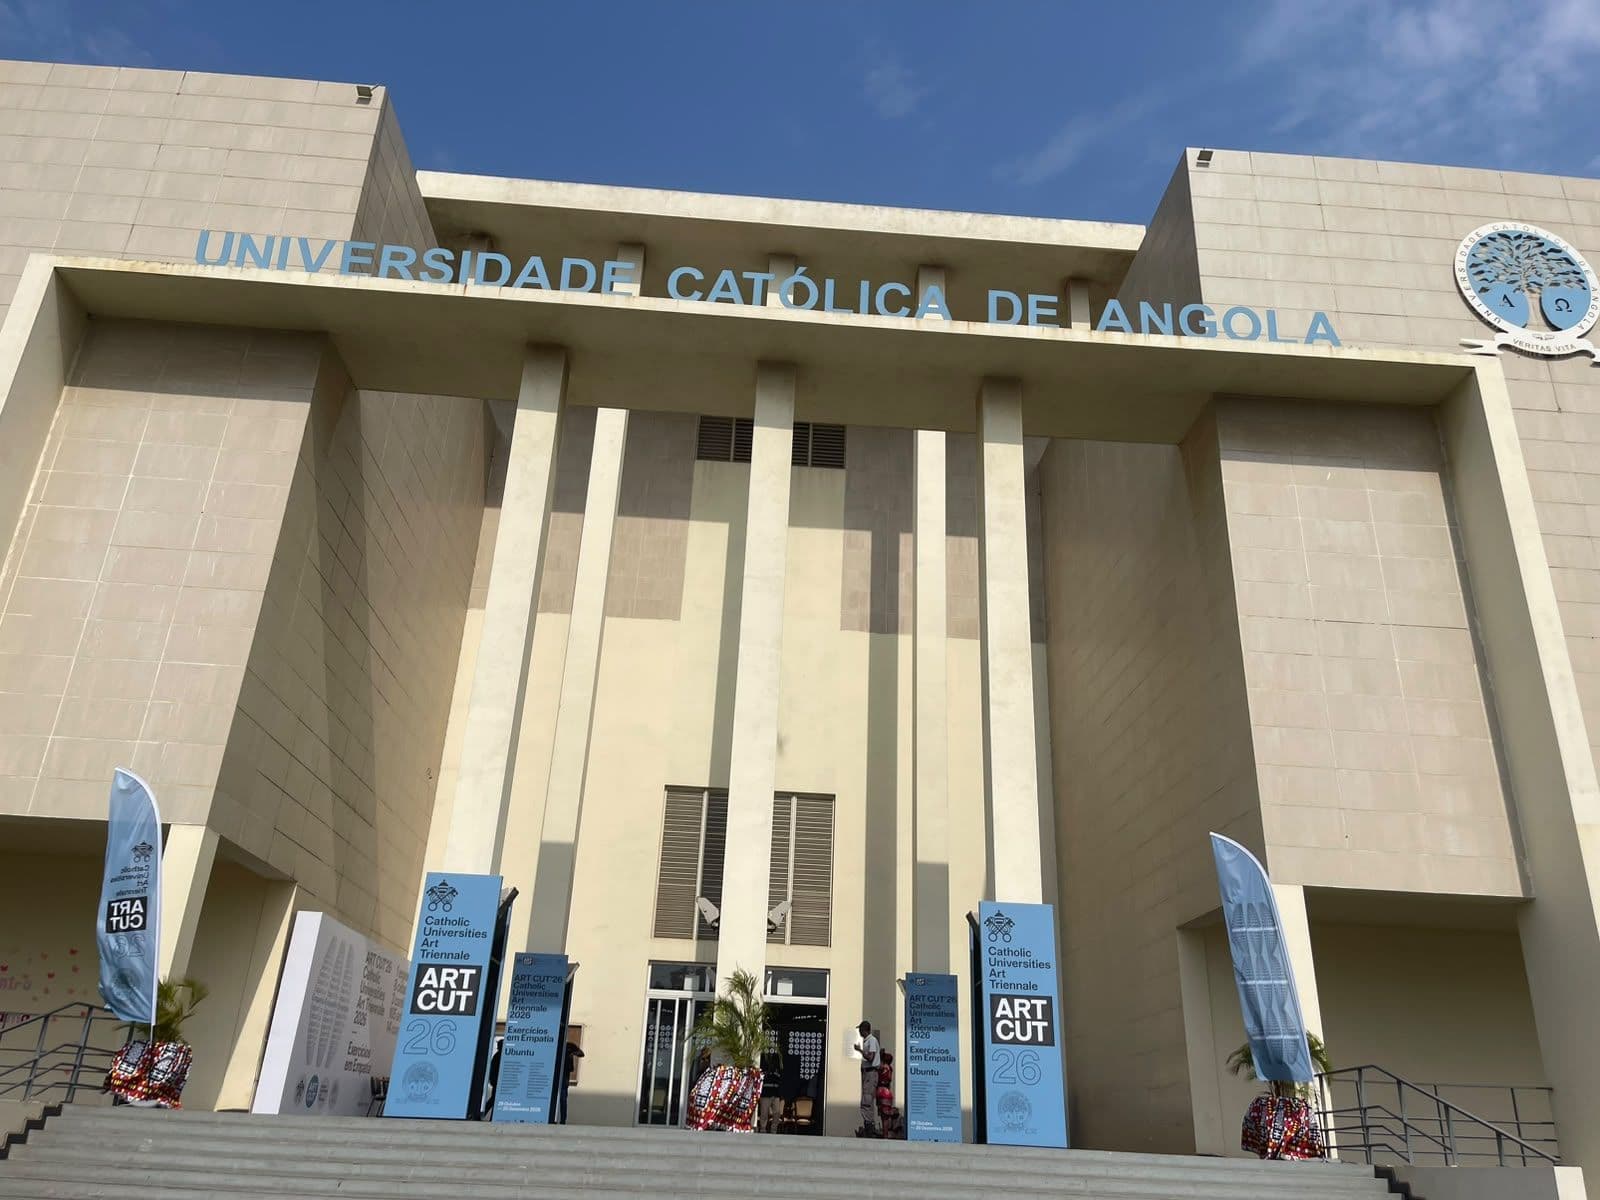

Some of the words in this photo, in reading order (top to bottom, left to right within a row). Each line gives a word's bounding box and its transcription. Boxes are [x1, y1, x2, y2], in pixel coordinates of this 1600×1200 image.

[194, 229, 637, 296] UNIVERSIDADE
[666, 265, 953, 320] CATÓLICA
[987, 288, 1061, 328] DE
[1097, 298, 1343, 348] ANGOLA
[425, 916, 471, 927] Catholic
[423, 927, 488, 939] Universities
[421, 938, 439, 948] Art
[420, 949, 471, 960] Triennale
[988, 946, 1032, 958] Catholic
[988, 957, 1051, 970] Universities
[514, 974, 532, 982] ART
[989, 968, 1006, 978] Art
[419, 967, 476, 990] ART
[513, 981, 546, 990] Catholic
[989, 979, 1039, 991] Triennale
[512, 989, 559, 998] Universities
[909, 994, 926, 1002] ART
[416, 989, 473, 1012] CUT
[511, 1004, 548, 1012] Triennale
[909, 1002, 941, 1010] Catholic
[995, 997, 1048, 1020] ART
[509, 1011, 531, 1019] 2026
[909, 1009, 955, 1018] Universities
[910, 1016, 922, 1024] Art
[507, 1025, 548, 1035] Exercícios
[910, 1024, 946, 1033] Triennale
[995, 1019, 1049, 1043] CUT
[402, 1018, 457, 1056] 26
[506, 1034, 520, 1042] em
[520, 1034, 554, 1044] Empatia
[909, 1031, 931, 1039] 2026
[504, 1047, 535, 1057] Ubuntu
[909, 1046, 950, 1055] Exercícios
[923, 1054, 956, 1063] Empatia
[909, 1067, 940, 1076] Ubuntu
[991, 1048, 1042, 1086] 26
